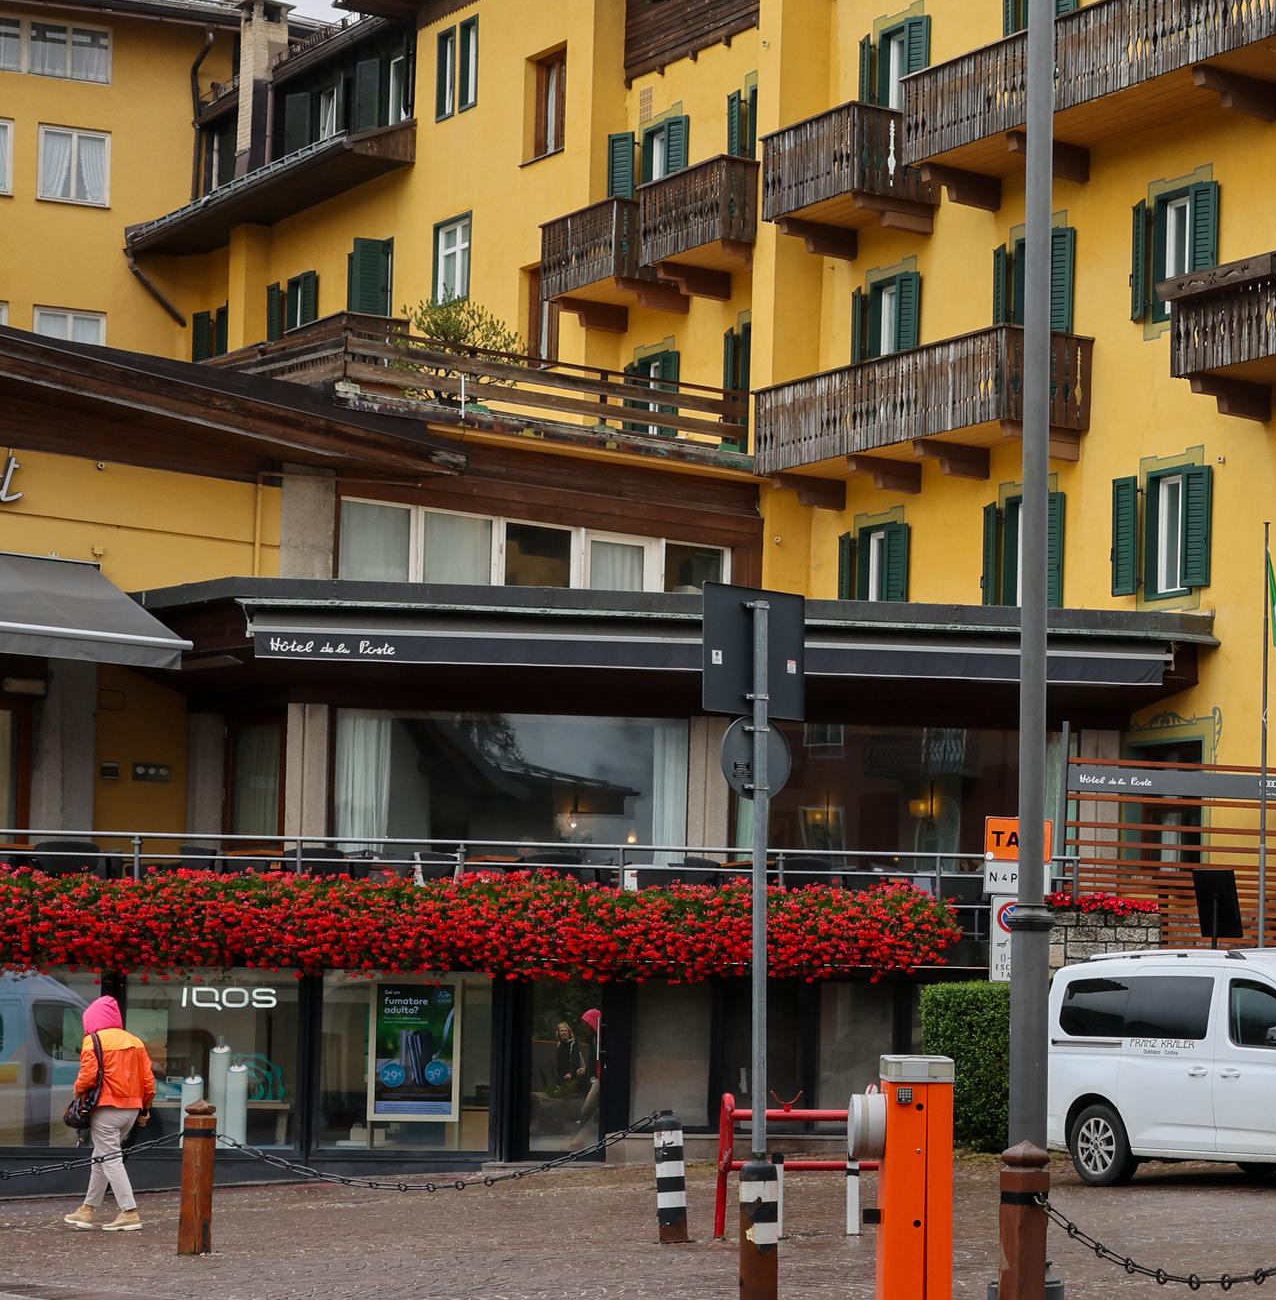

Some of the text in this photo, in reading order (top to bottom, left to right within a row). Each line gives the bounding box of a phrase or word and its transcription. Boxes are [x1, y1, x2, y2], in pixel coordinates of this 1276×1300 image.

[269, 637, 314, 653] Hôtel
[359, 640, 396, 655] Poste
[1130, 776, 1152, 787] Poste
[991, 830, 1019, 848] TA
[181, 986, 278, 1012] IQOS
[384, 996, 429, 1006] fumatore
[384, 1005, 419, 1015] adulto?
[1130, 1038, 1195, 1049] FRANZ KRALER
